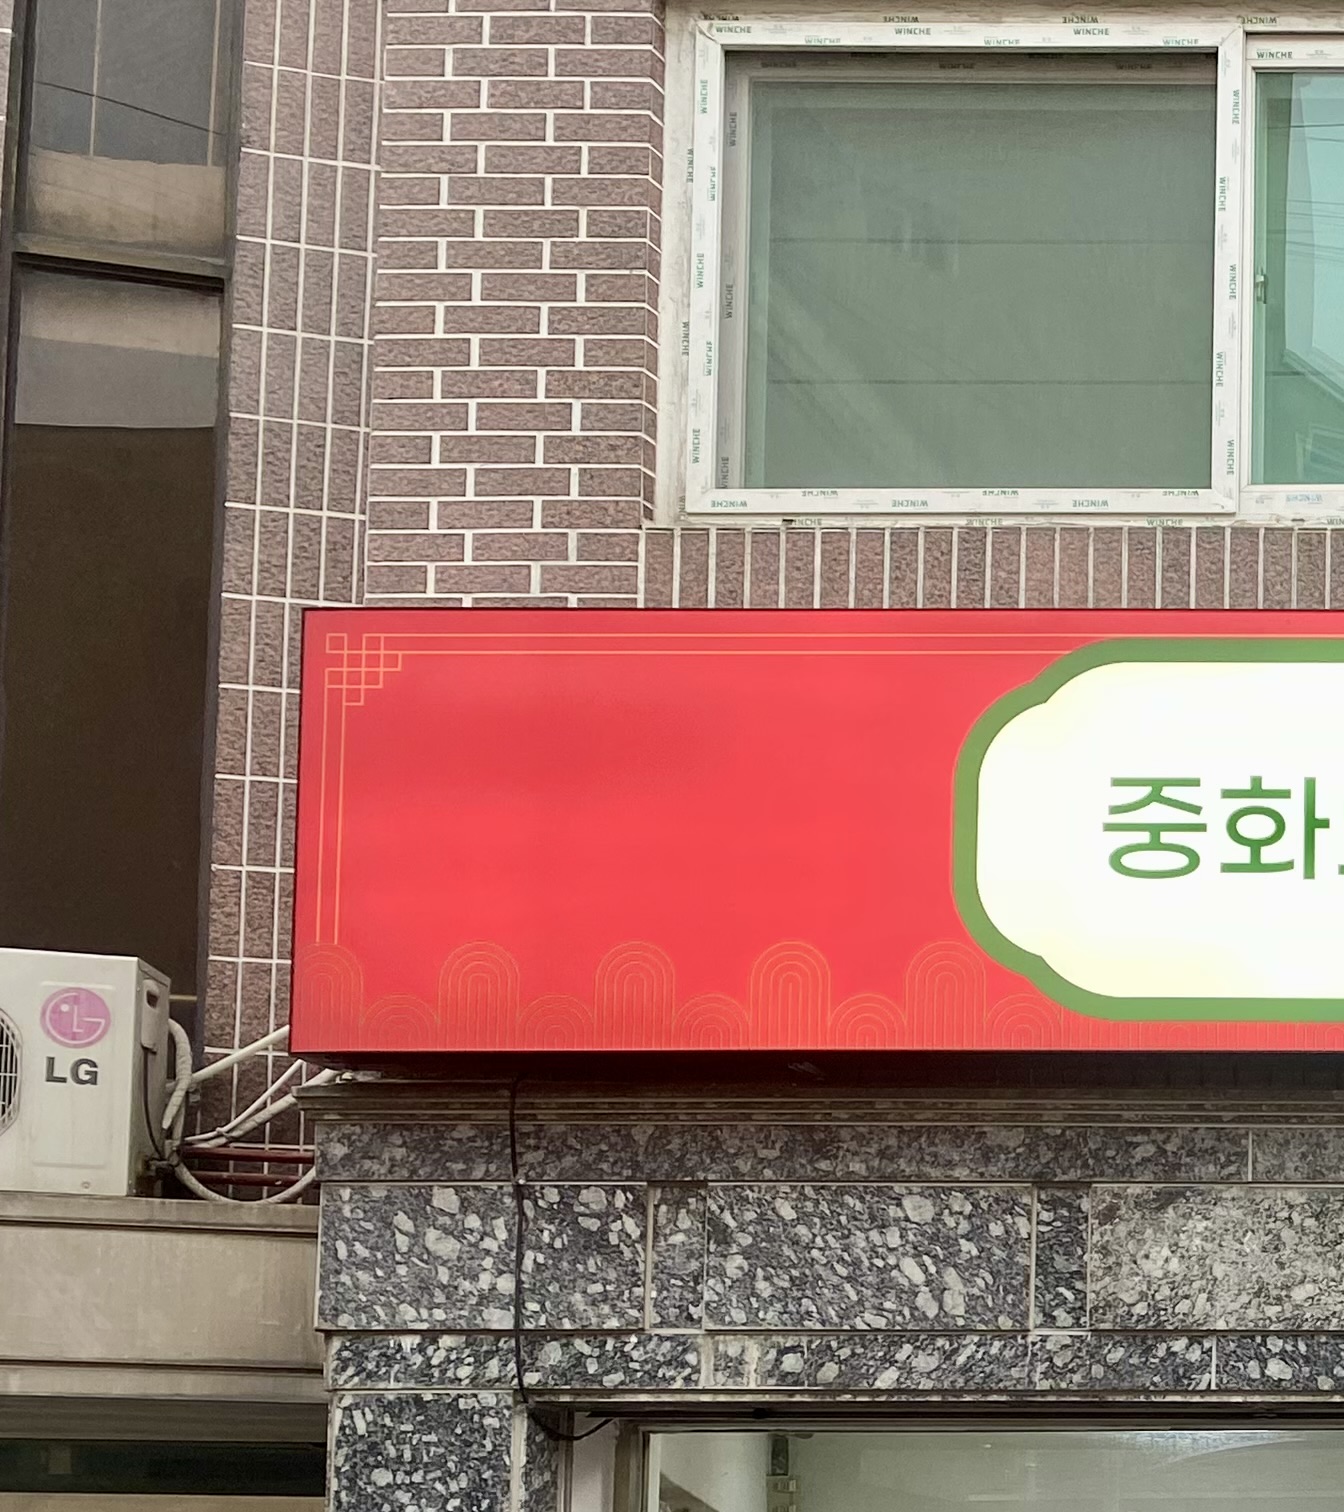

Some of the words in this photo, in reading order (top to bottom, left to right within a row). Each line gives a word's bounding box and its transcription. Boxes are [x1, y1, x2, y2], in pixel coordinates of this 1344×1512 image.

[894, 28, 931, 36] WINCHE
[1073, 28, 1109, 36] WINCHE
[700, 80, 708, 114] WINCHE
[1232, 90, 1240, 124] WINCHE
[729, 112, 737, 146] WINCHE
[1218, 176, 1226, 212] WINCHE
[696, 253, 705, 288] WINCHE
[725, 284, 733, 318] WINCHE
[692, 428, 700, 463] WINCHE
[711, 500, 748, 508] WINCHE
[892, 500, 928, 508] WINCHE
[1072, 500, 1108, 508] WINCHE
[45, 1056, 99, 1085] LG
